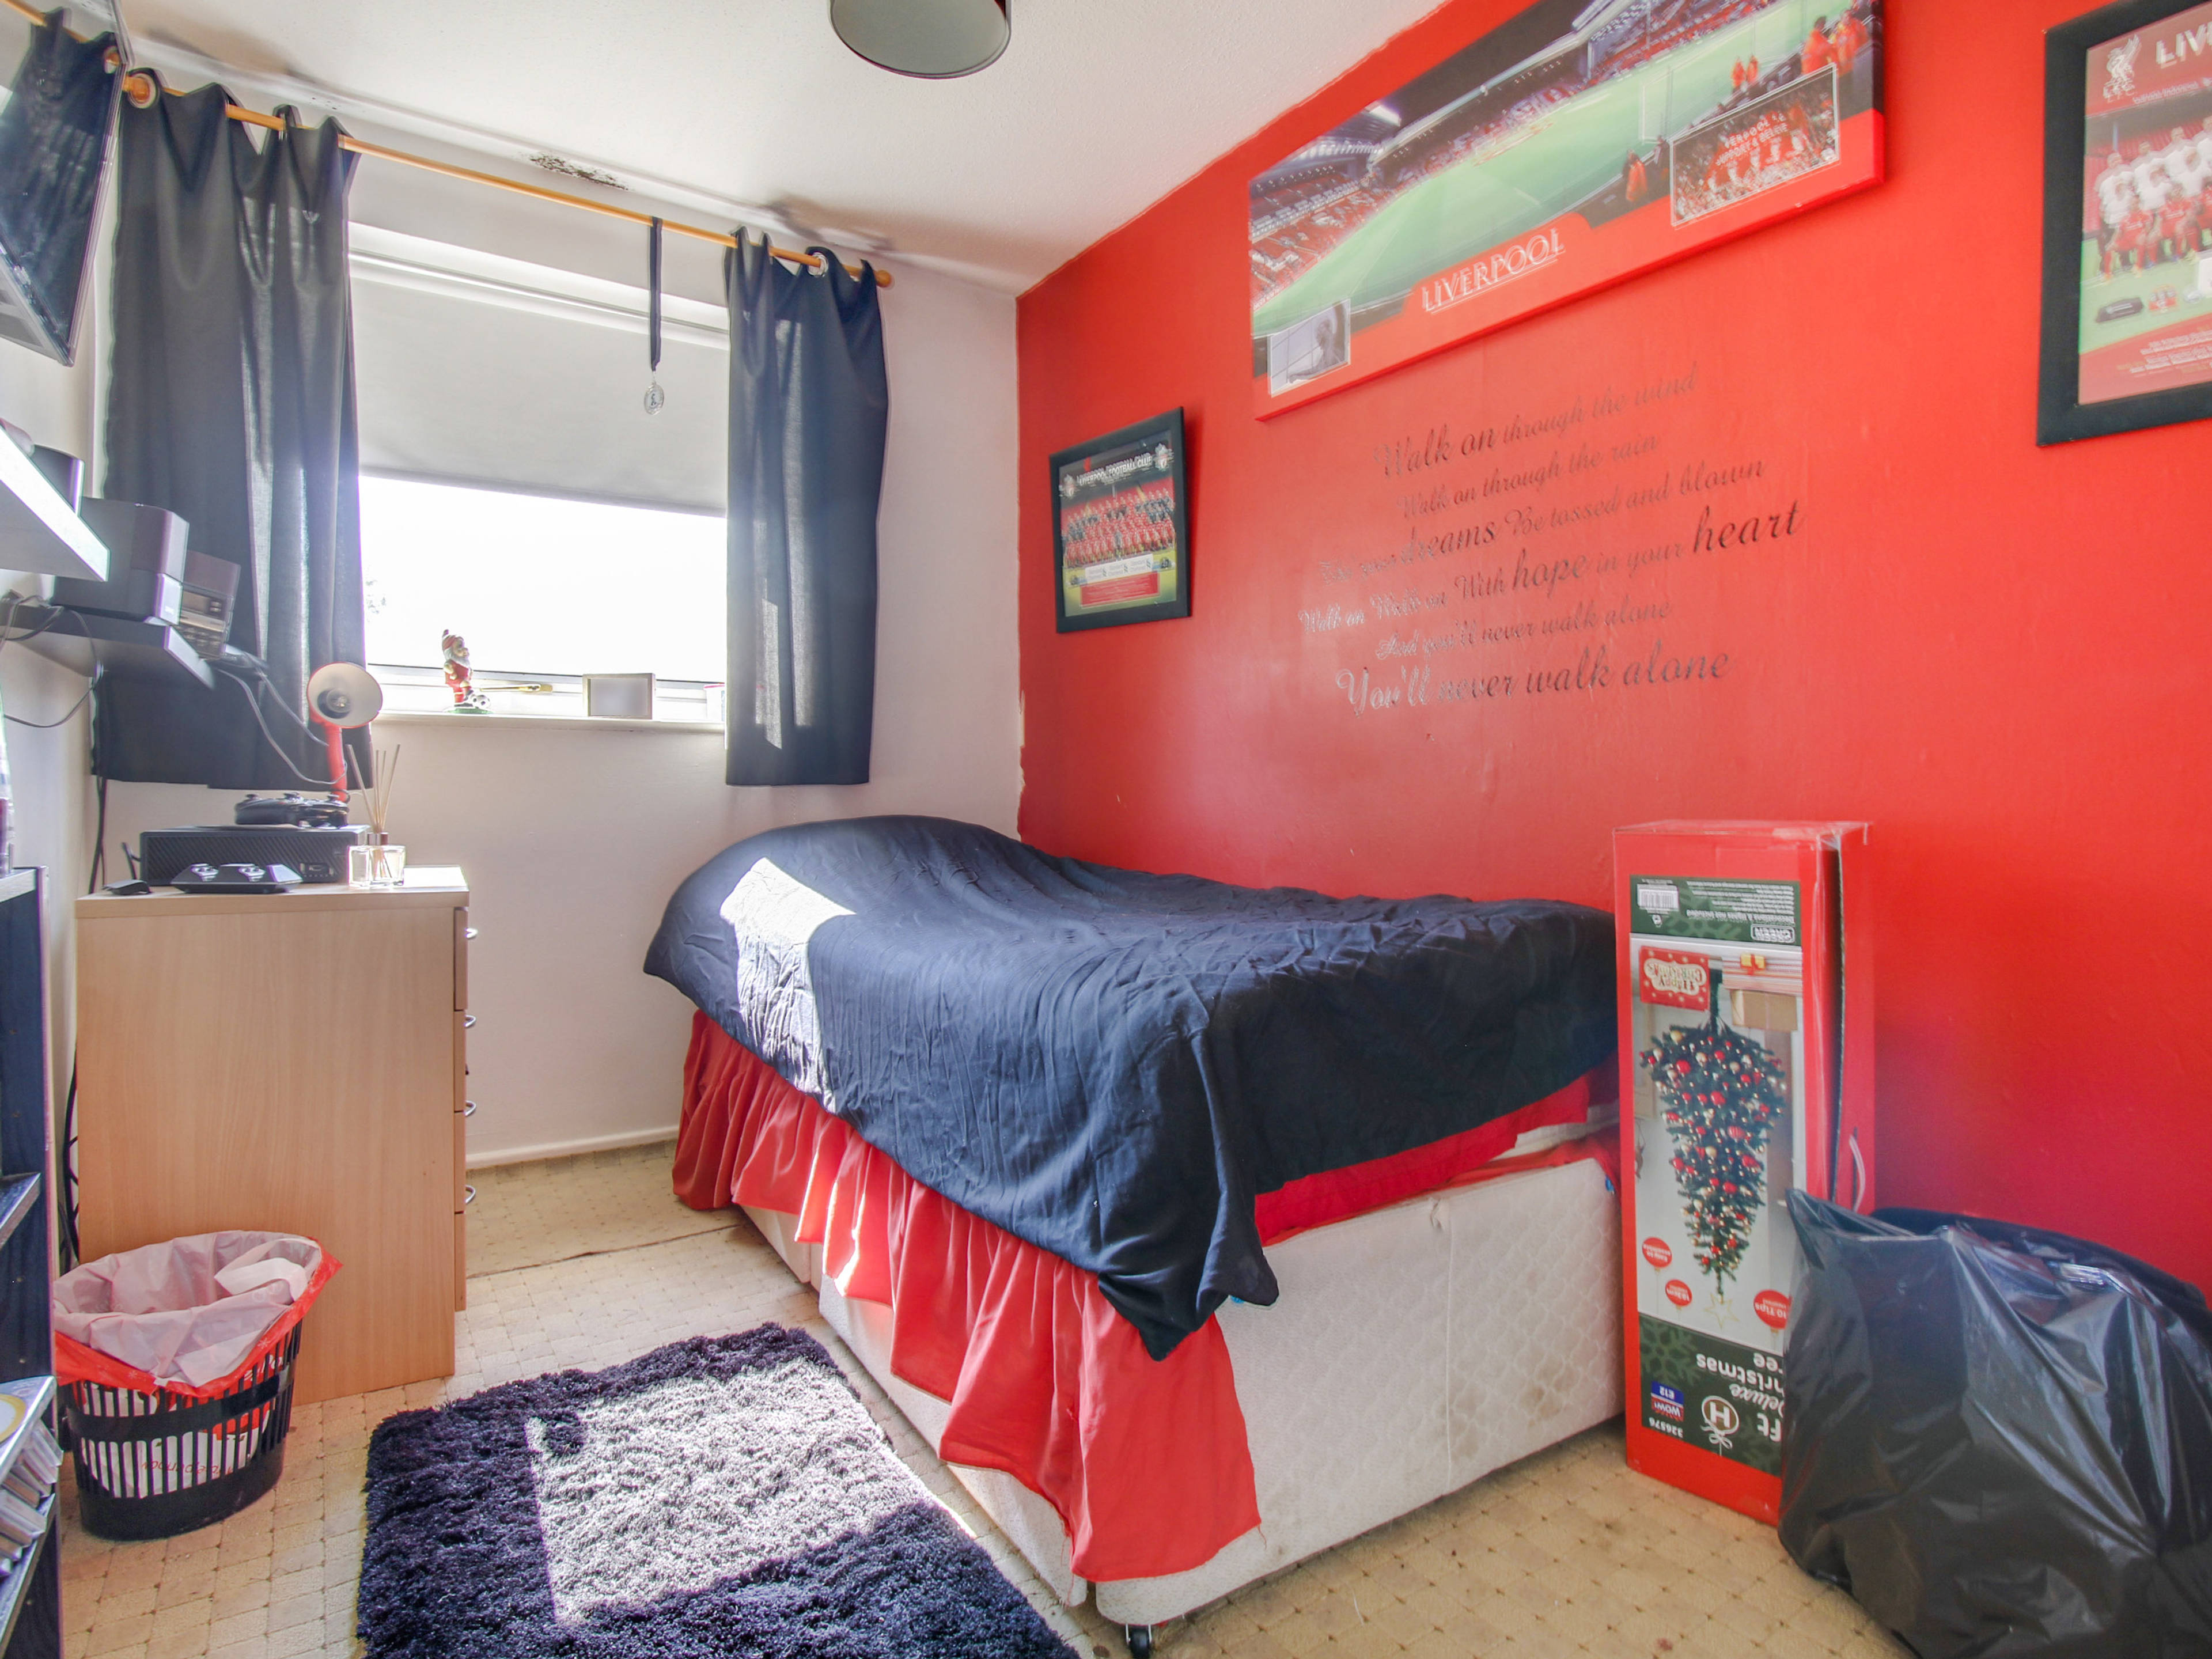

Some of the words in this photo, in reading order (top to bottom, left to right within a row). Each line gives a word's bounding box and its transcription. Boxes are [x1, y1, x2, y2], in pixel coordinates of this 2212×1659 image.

[1422, 228, 1565, 312] LIVERPOOL
[1373, 424, 1451, 478] Walk
[1461, 427, 1496, 456] on
[1503, 395, 1585, 444] through
[1592, 386, 1623, 418] the
[1635, 361, 1698, 406] wind
[1453, 486, 1477, 505] on
[1483, 451, 1562, 497] through
[1569, 442, 1603, 474] the
[1611, 433, 1659, 460] rain
[1401, 522, 1496, 565] dreams
[1505, 506, 1543, 536] Be
[1626, 471, 1670, 508] and
[1680, 460, 1764, 495] blown
[1512, 548, 1588, 598] hope
[1596, 552, 1617, 574] in
[1627, 543, 1683, 578] your
[1692, 499, 1800, 554] heart
[1481, 620, 1536, 641] never
[1542, 600, 1598, 634] walk
[1605, 594, 1671, 626] alone
[1335, 664, 1431, 718] You'll
[1438, 675, 1513, 704] never
[1527, 645, 1610, 693] walk
[1623, 639, 1730, 686] alone
[1755, 1302, 1775, 1317] Tips
[1696, 1353, 1785, 1397] hristmas
[1753, 1352, 1784, 1374] ee
[1648, 1416, 1684, 1438] 326576
[1710, 1401, 1730, 1429] H
[1757, 1412, 1782, 1442] ft
